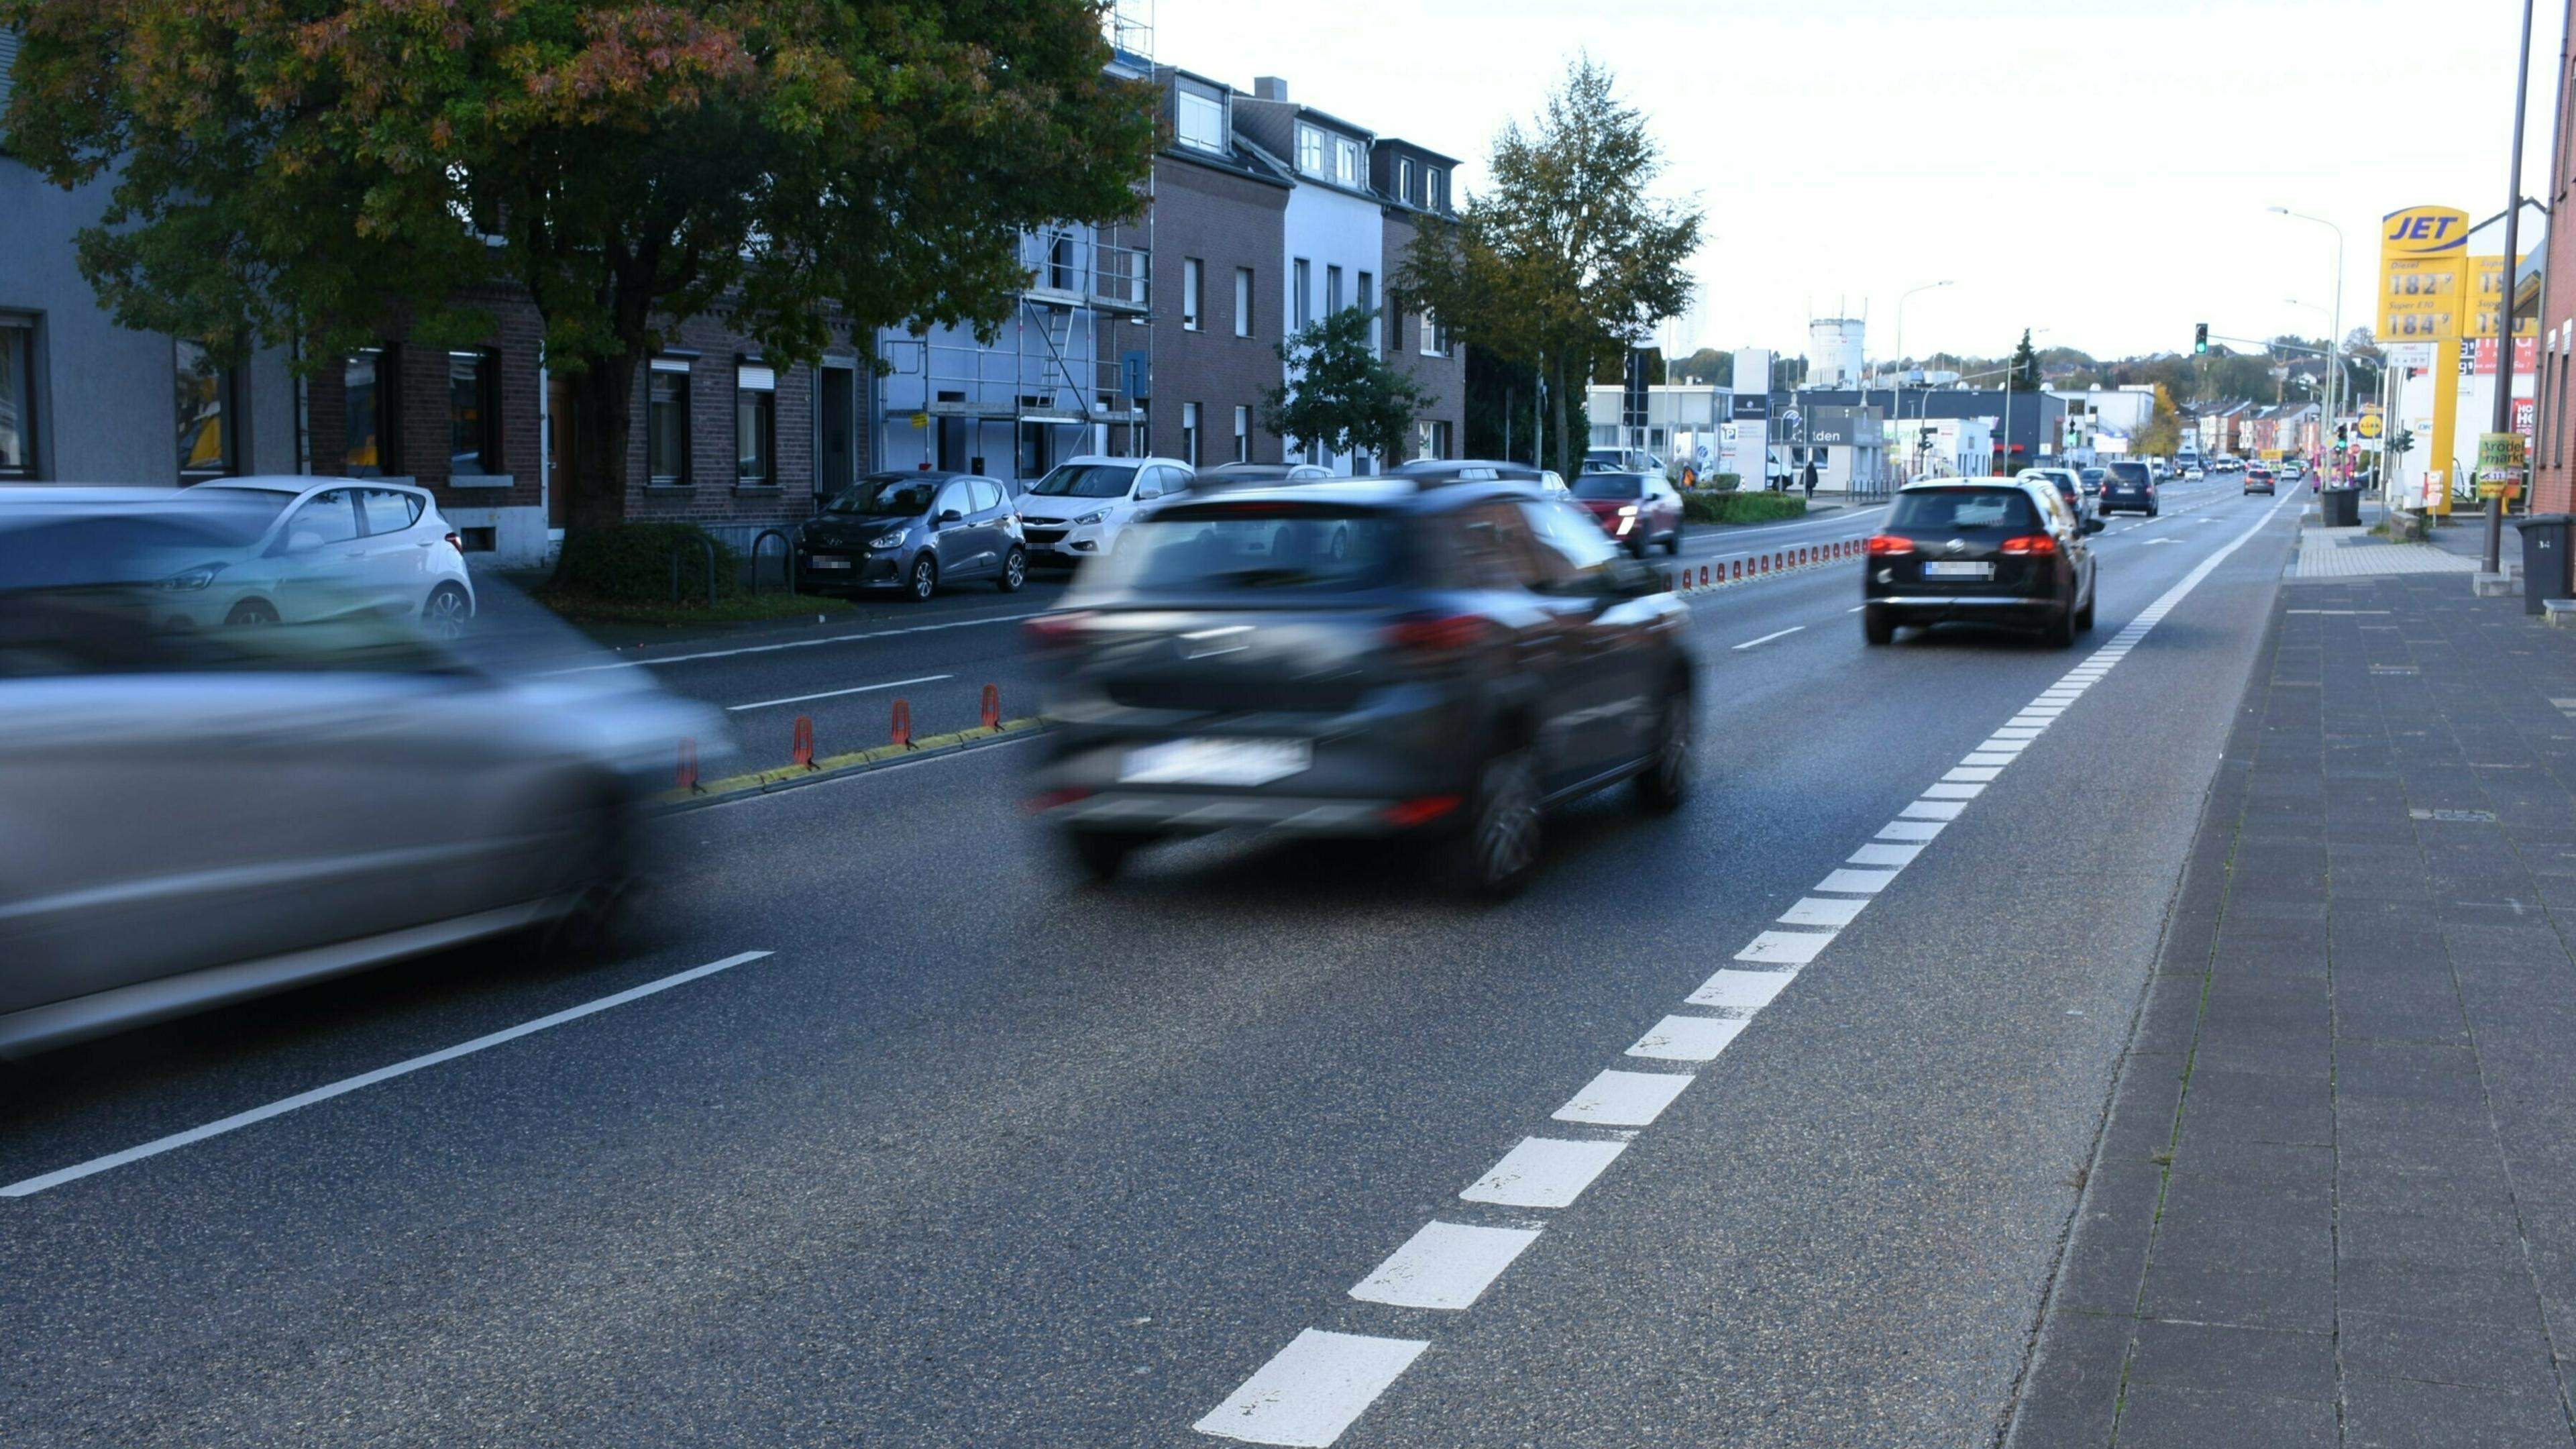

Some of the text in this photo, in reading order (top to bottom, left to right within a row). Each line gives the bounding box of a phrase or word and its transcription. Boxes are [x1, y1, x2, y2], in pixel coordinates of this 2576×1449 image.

[2389, 217, 2459, 239] JET
[2391, 261, 2419, 269] Diesel
[2390, 301, 2414, 311] Super
